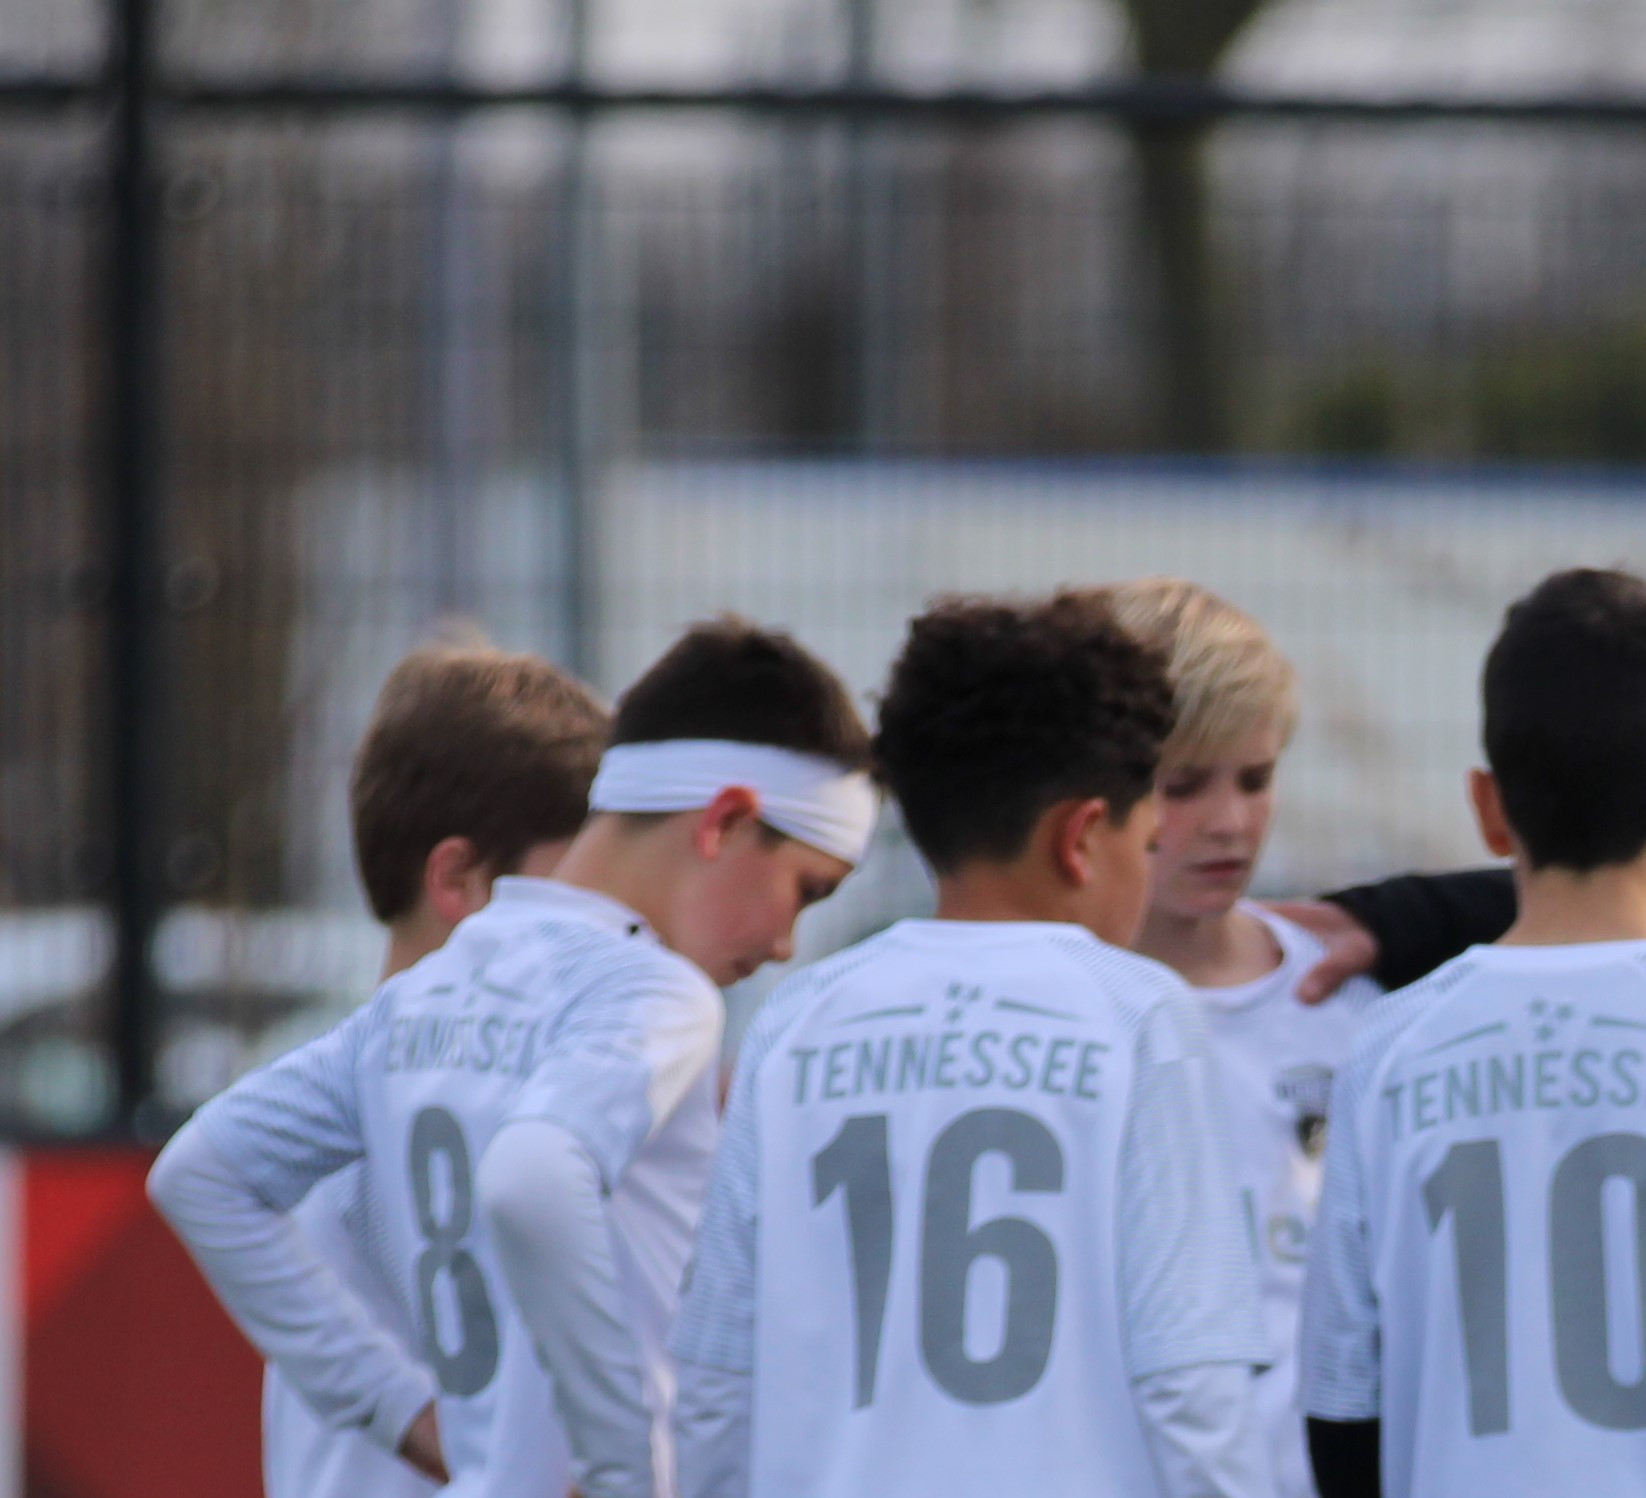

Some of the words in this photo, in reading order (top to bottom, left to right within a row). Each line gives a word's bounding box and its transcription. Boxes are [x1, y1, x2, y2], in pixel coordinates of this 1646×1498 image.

[790, 1031, 1112, 1103] TENNESSEE
[410, 1106, 499, 1396] 8
[811, 1107, 1064, 1412] 16
